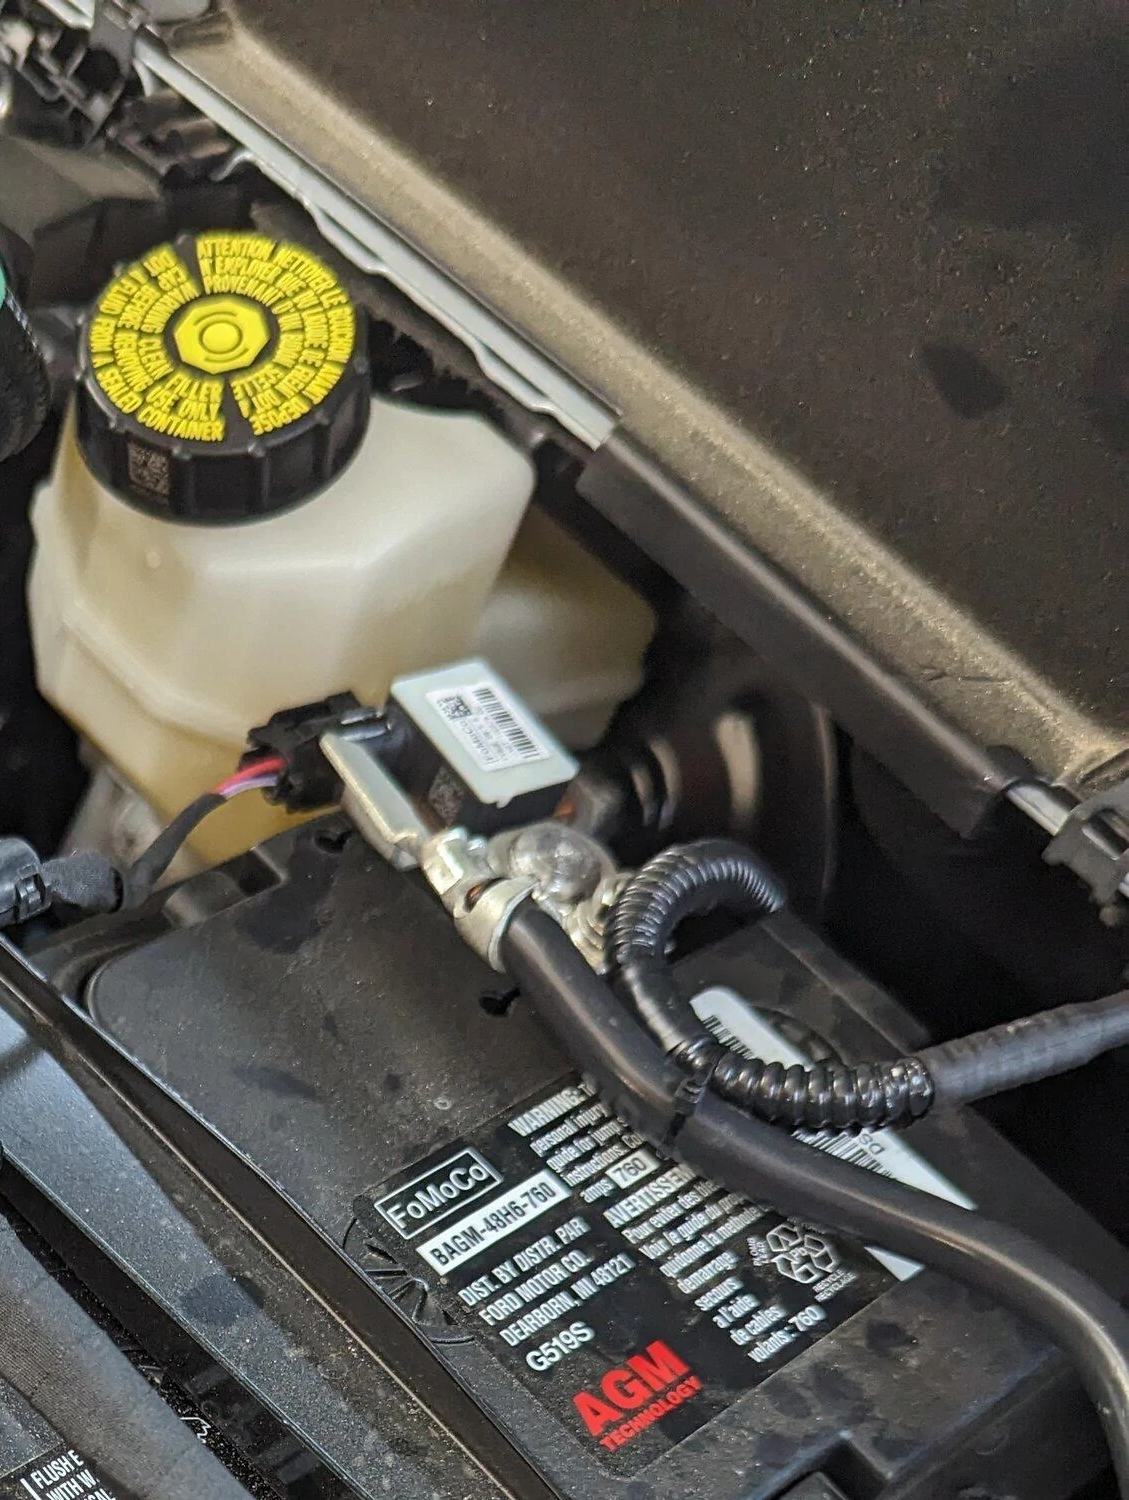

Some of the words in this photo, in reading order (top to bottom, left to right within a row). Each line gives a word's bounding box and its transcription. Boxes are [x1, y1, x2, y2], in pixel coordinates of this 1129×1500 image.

[137, 336, 174, 381] CLEAN
[163, 374, 224, 403] FILLER
[96, 367, 143, 414] SEALED
[137, 405, 225, 442] CONTAINER
[145, 385, 179, 413] USE
[178, 399, 222, 422] ONLY
[507, 1088, 585, 1136] WARNING:
[529, 1119, 578, 1157] personal
[546, 1145, 581, 1173] guide
[572, 1136, 595, 1152] for
[587, 1120, 622, 1146] jump
[385, 1163, 488, 1229] FoMoCo
[579, 1177, 614, 1203] amps
[612, 1156, 647, 1181] 760
[603, 1164, 694, 1228] AVERTISSEM
[429, 1181, 556, 1265] BAGM-48H6-760
[621, 1221, 655, 1244] Pour
[648, 1202, 683, 1228] eviter
[676, 1190, 702, 1209] des
[638, 1238, 669, 1259] Voir
[662, 1230, 682, 1246] le
[676, 1211, 710, 1241] guide
[703, 1203, 723, 1220] du
[715, 1206, 761, 1240] methode
[457, 1275, 500, 1306] DIST.
[491, 1260, 519, 1283] BY
[512, 1236, 561, 1271] DISTR.
[554, 1217, 587, 1244] PAR
[478, 1292, 522, 1325] FORD
[514, 1263, 568, 1302] MOTOR
[560, 1250, 592, 1272] CO.
[499, 1291, 580, 1346] DEARBORN,
[570, 1277, 597, 1299] MI
[590, 1254, 633, 1285] 48121
[694, 1276, 741, 1311] secours
[787, 1305, 824, 1331] 760
[525, 1322, 593, 1370] G519S
[712, 1315, 729, 1328] a
[729, 1328, 754, 1345] de
[744, 1305, 785, 1335] cables
[572, 1340, 687, 1436] AGM
[599, 1375, 699, 1451] TECHNOLOGY
[30, 1455, 75, 1489] FLUSH
